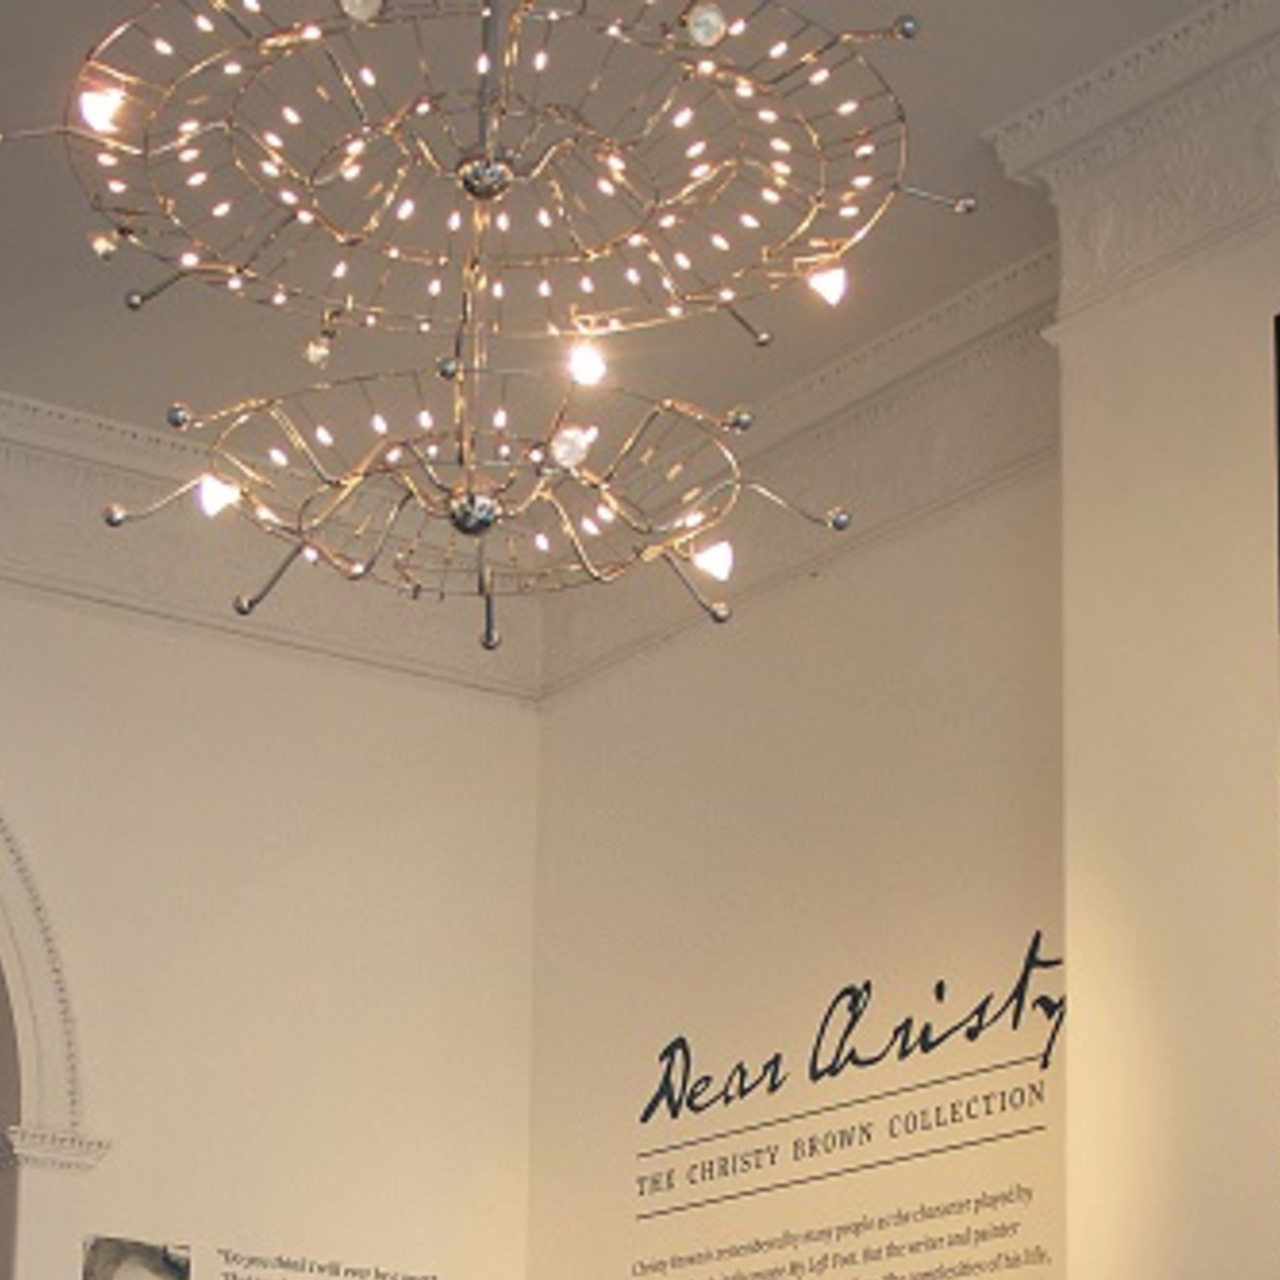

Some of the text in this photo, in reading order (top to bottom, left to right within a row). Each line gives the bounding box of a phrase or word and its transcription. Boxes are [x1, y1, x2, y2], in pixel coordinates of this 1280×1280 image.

[639, 1035, 788, 1124] Dear
[635, 1080, 1047, 1198] THE CHRISTY BROWN COLLECTION
